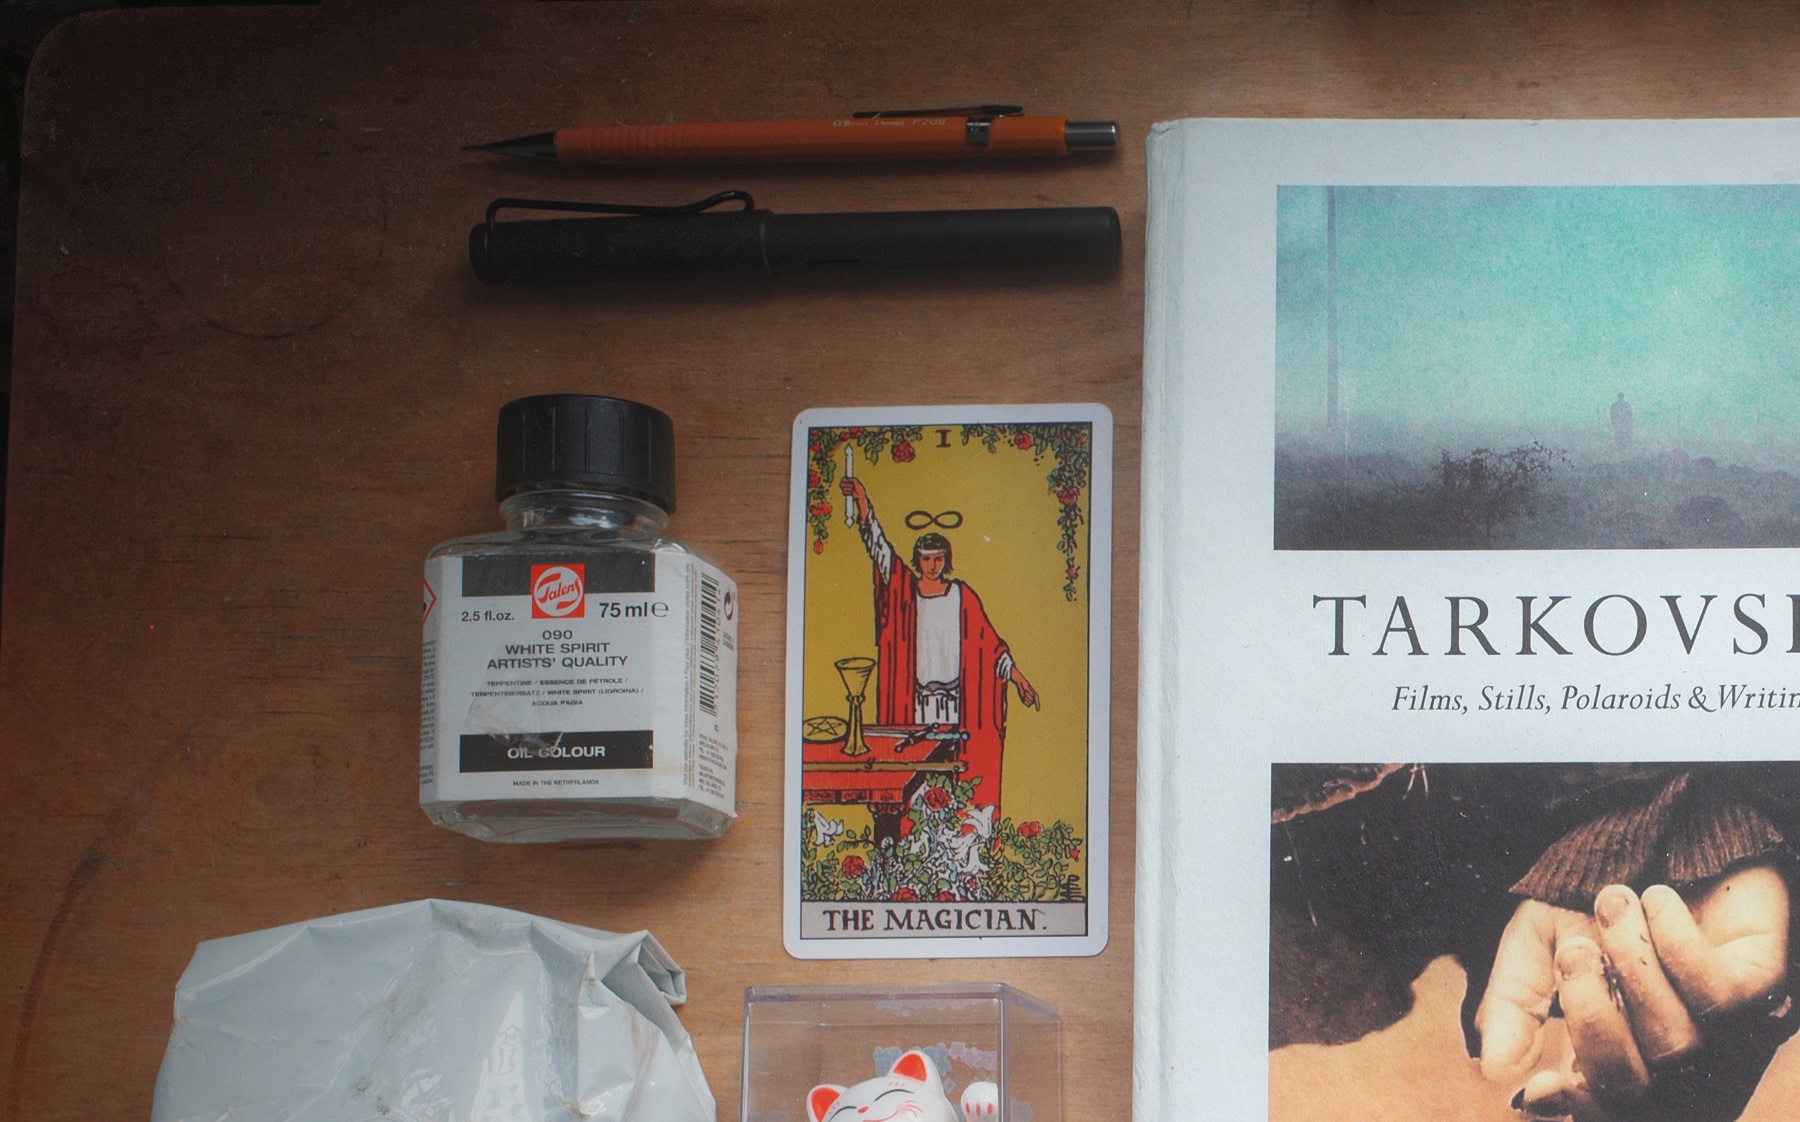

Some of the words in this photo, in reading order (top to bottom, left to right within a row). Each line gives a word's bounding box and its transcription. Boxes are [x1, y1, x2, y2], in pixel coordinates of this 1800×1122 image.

[461, 611, 480, 622] 2.5
[484, 610, 515, 622] fl.oz.
[599, 602, 621, 618] 75
[625, 601, 647, 617] ml
[542, 630, 573, 641] 090
[505, 644, 555, 655] WHITE
[560, 642, 610, 654] SPIRIT
[487, 657, 556, 669] ARTISTS'
[562, 656, 628, 668] QUALITY
[1391, 685, 1468, 714] Films,
[1478, 684, 1552, 714] Stills,
[1560, 684, 1681, 711] Polaroids
[1687, 685, 1718, 712] &
[507, 746, 533, 759] OIL
[538, 746, 606, 758] COLOUR
[823, 908, 875, 931] THE
[883, 906, 1047, 932] MAGICIAN.
